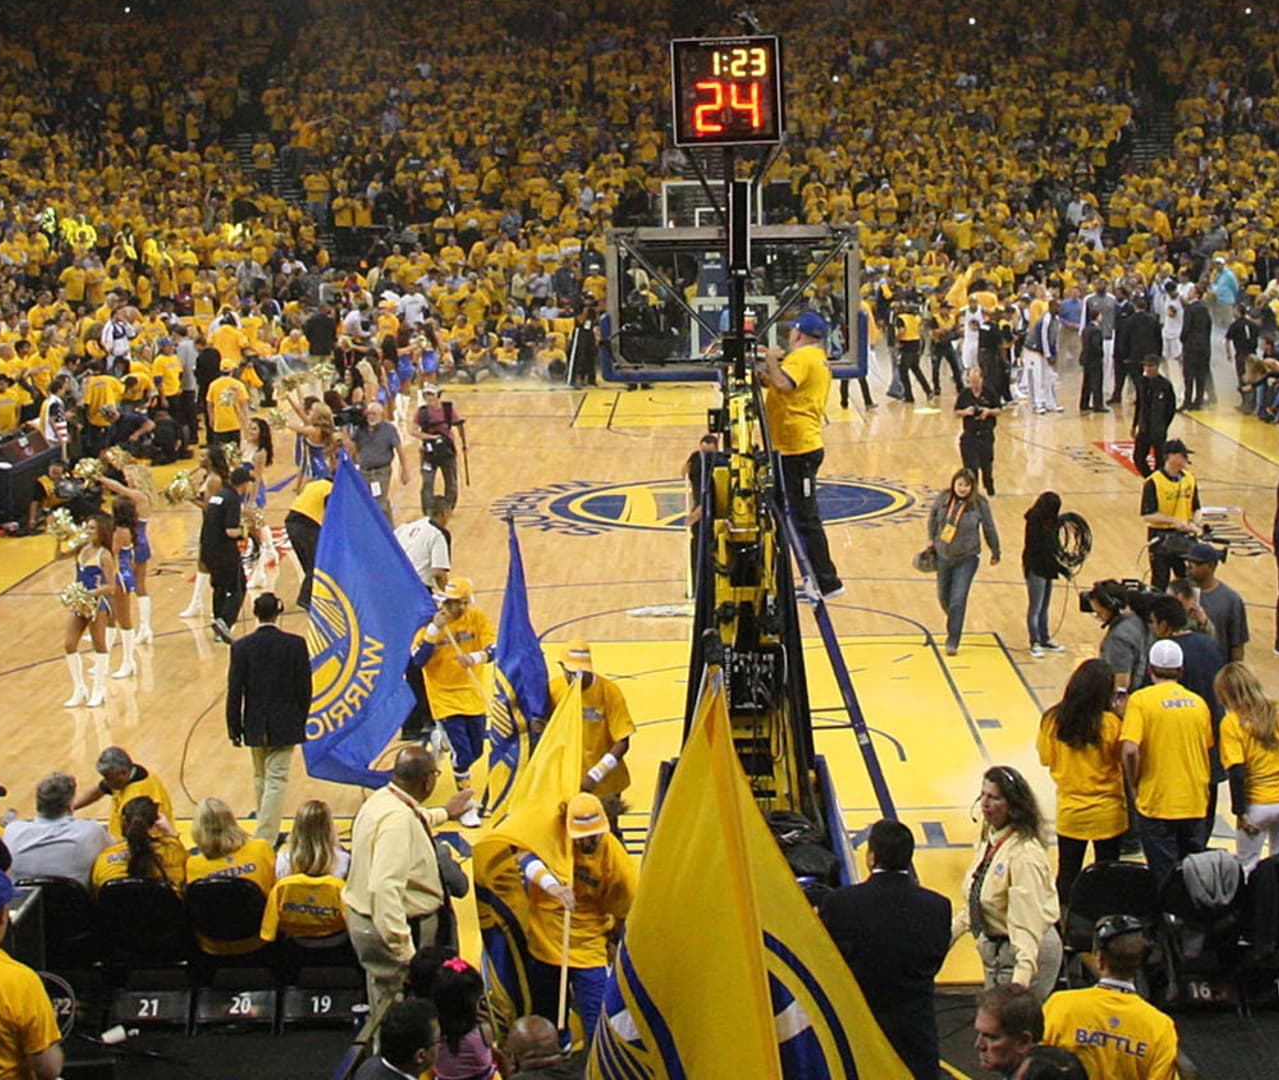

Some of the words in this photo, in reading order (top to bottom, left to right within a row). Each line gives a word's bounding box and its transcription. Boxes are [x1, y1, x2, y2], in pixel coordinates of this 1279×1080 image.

[712, 47, 767, 77] 1:23
[694, 82, 762, 136] 24
[1161, 698, 1197, 709] UNITE
[282, 902, 340, 918] PROTECT
[1189, 982, 1211, 999] 16
[138, 999, 159, 1016] 21
[229, 997, 252, 1014] 20
[310, 995, 332, 1013] 19
[1075, 1028, 1148, 1057] BATTLE
